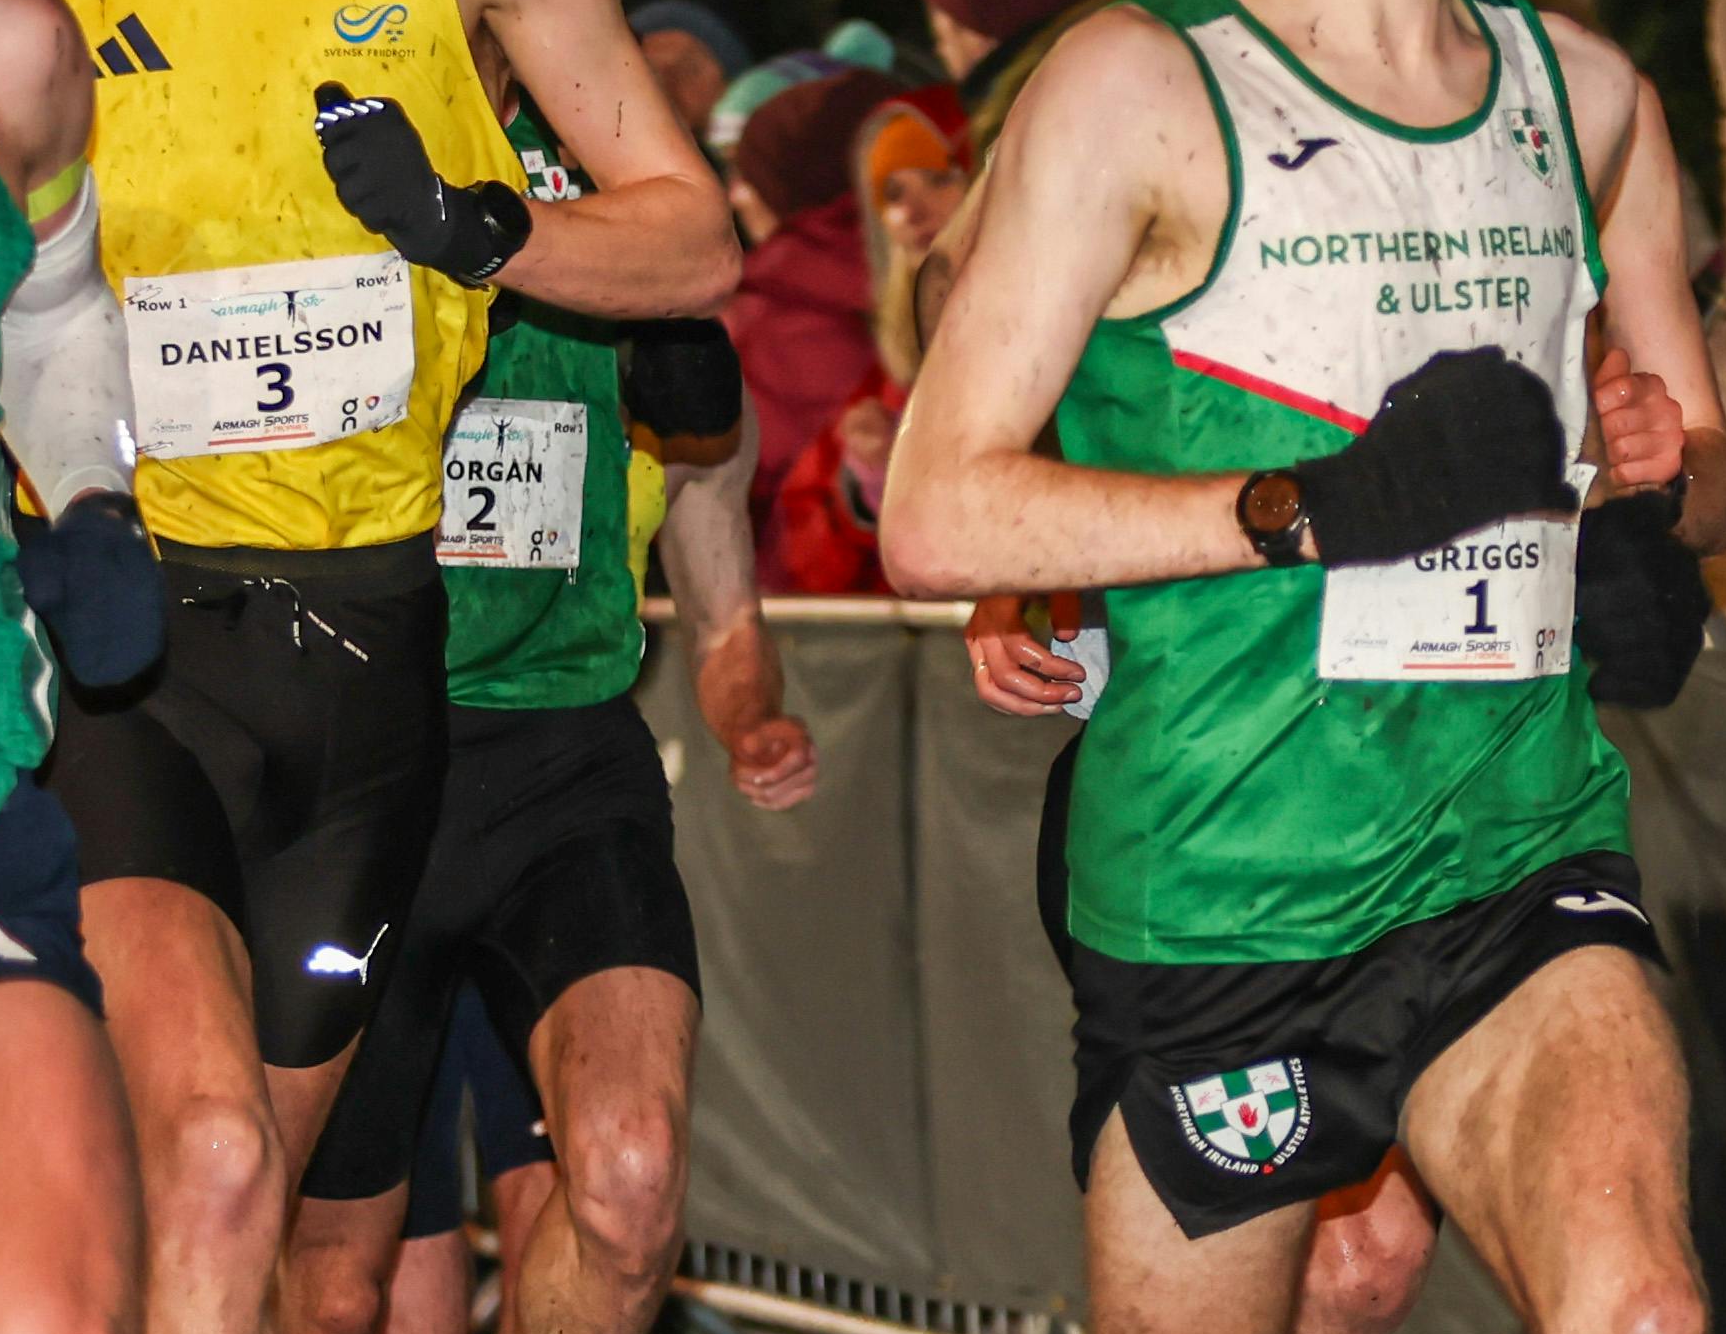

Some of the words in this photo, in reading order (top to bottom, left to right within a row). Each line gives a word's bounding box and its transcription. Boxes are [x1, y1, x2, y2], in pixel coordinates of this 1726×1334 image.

[323, 48, 364, 58] SVENSK
[367, 48, 416, 59] FRIIDROTT
[1259, 229, 1470, 269] NORTHERN
[1479, 225, 1574, 258] IRELAND
[356, 273, 390, 289] Row
[393, 271, 403, 283] 1
[137, 298, 173, 313] Row
[178, 297, 188, 309] 1
[211, 298, 280, 318] armagh
[1376, 283, 1400, 315] &
[1411, 276, 1531, 314] ULSTER
[160, 320, 384, 367] DANIELSSON
[256, 361, 295, 413] 3
[212, 419, 261, 433] ARMAGH
[264, 414, 310, 427] SPORTS
[554, 422, 576, 434] Row
[446, 459, 543, 483] ORGAN
[466, 486, 497, 531] 2
[1414, 542, 1540, 572] GRIGGS
[1464, 578, 1498, 636] 1
[1409, 640, 1462, 653] ARMAGH
[1465, 639, 1512, 653] SPORTS
[1288, 1056, 1312, 1126] ATHLETICS
[1169, 1084, 1207, 1153] NORTHERN
[1273, 1124, 1309, 1166] ULSTER
[1204, 1148, 1260, 1175] IRELAND
